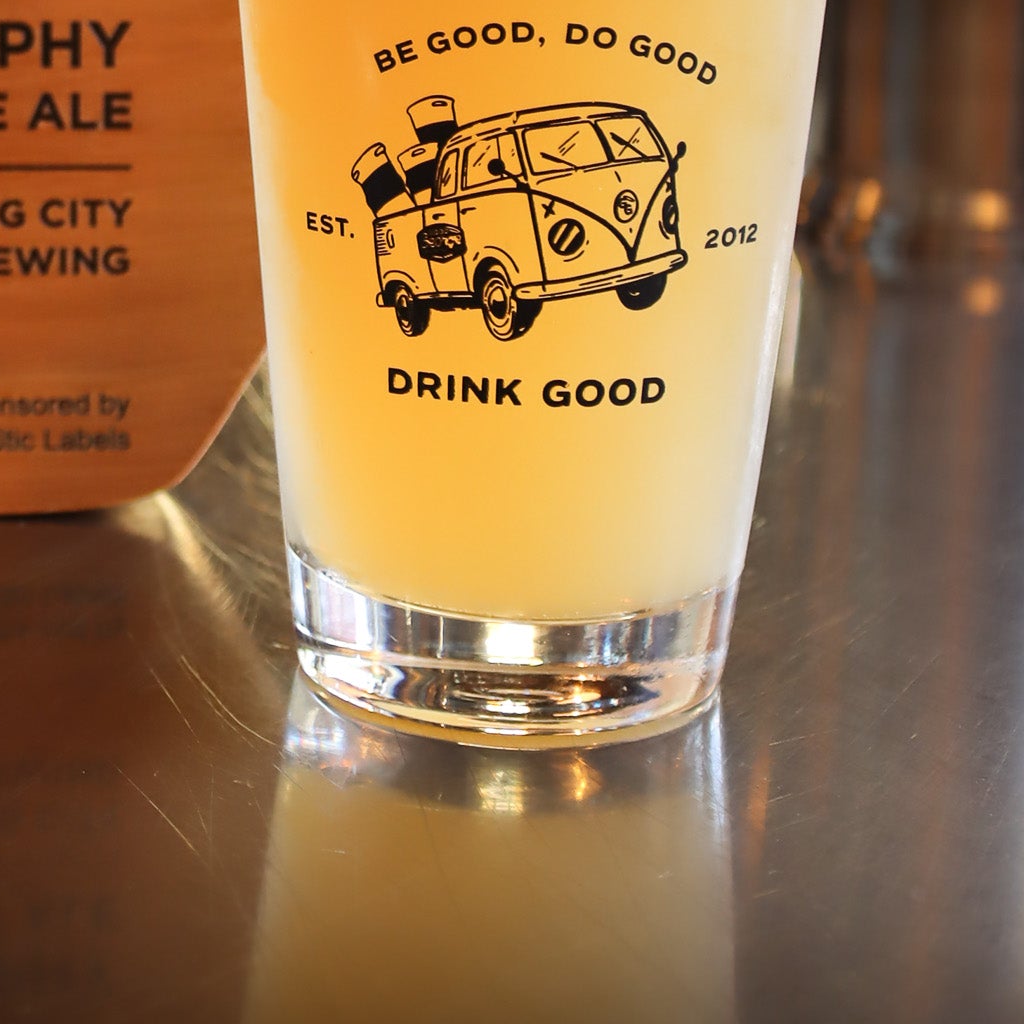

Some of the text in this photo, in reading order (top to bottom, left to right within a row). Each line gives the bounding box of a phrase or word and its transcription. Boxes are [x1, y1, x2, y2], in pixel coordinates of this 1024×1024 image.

[373, 22, 718, 85] BE GOOD, DO GOOD
[28, 92, 133, 130] ALE
[40, 199, 132, 229] CITY
[306, 211, 355, 239] EST.
[704, 223, 759, 250] 2012
[387, 367, 667, 408] DRINK GOOD
[98, 393, 131, 421] by
[43, 428, 131, 452] Labels
